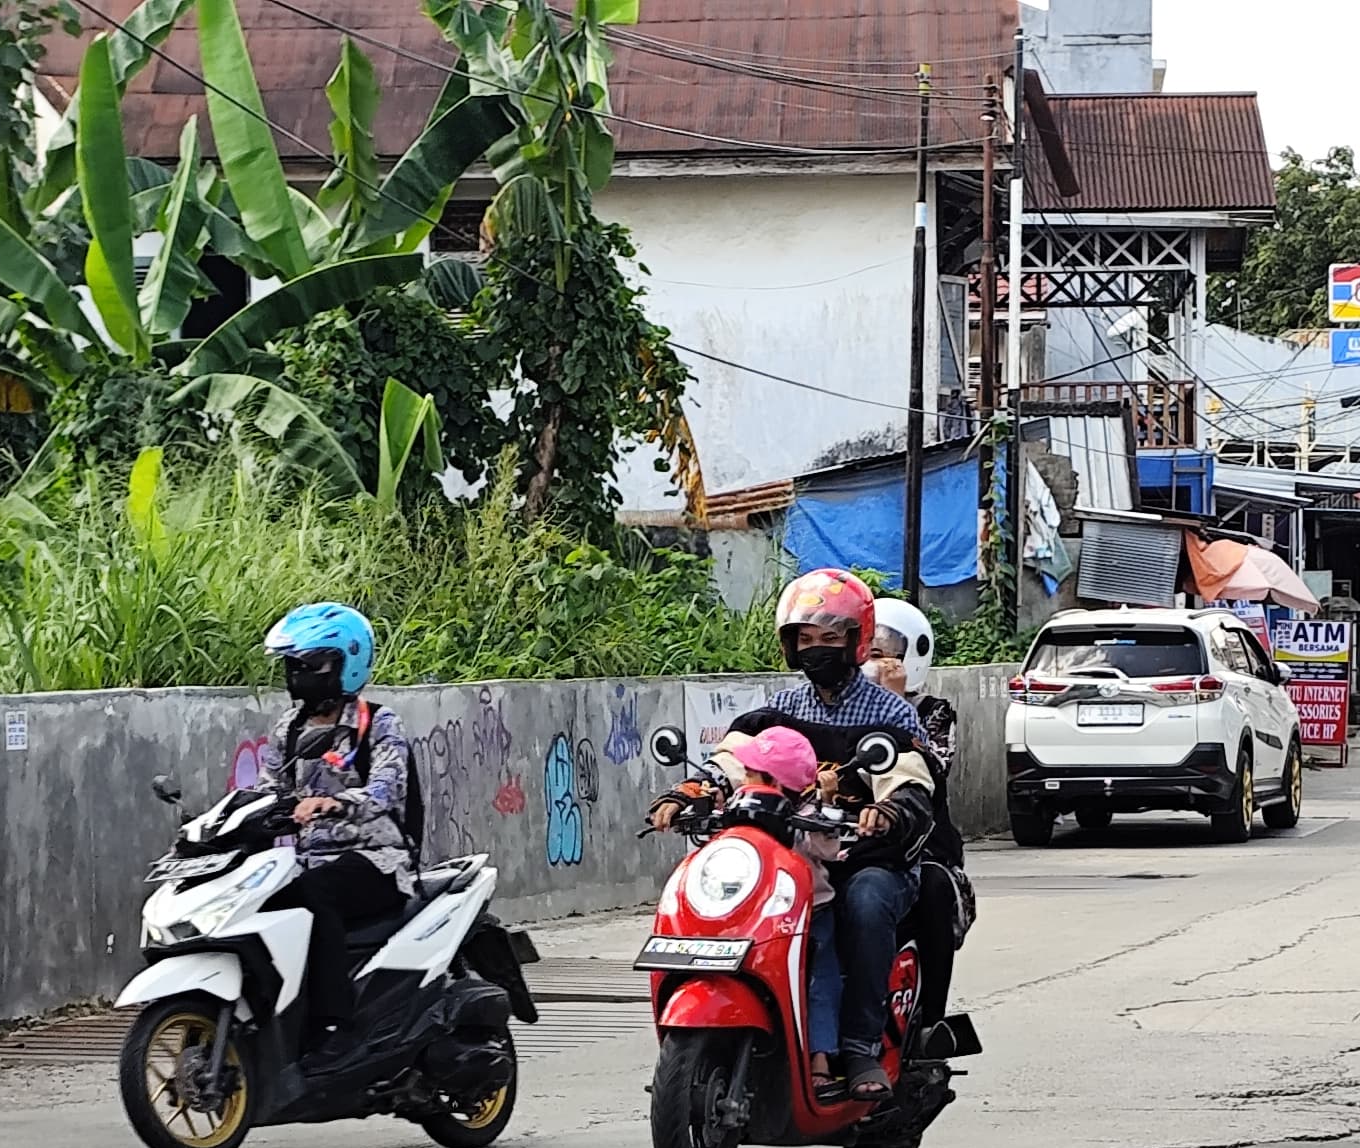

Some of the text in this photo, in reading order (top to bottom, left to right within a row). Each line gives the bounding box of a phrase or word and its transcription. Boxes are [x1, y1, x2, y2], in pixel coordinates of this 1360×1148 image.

[1292, 622, 1345, 643] ATM
[1298, 644, 1340, 652] BERSAMA
[1303, 686, 1346, 703] INTERNET
[1300, 723, 1338, 739] VICE HP
